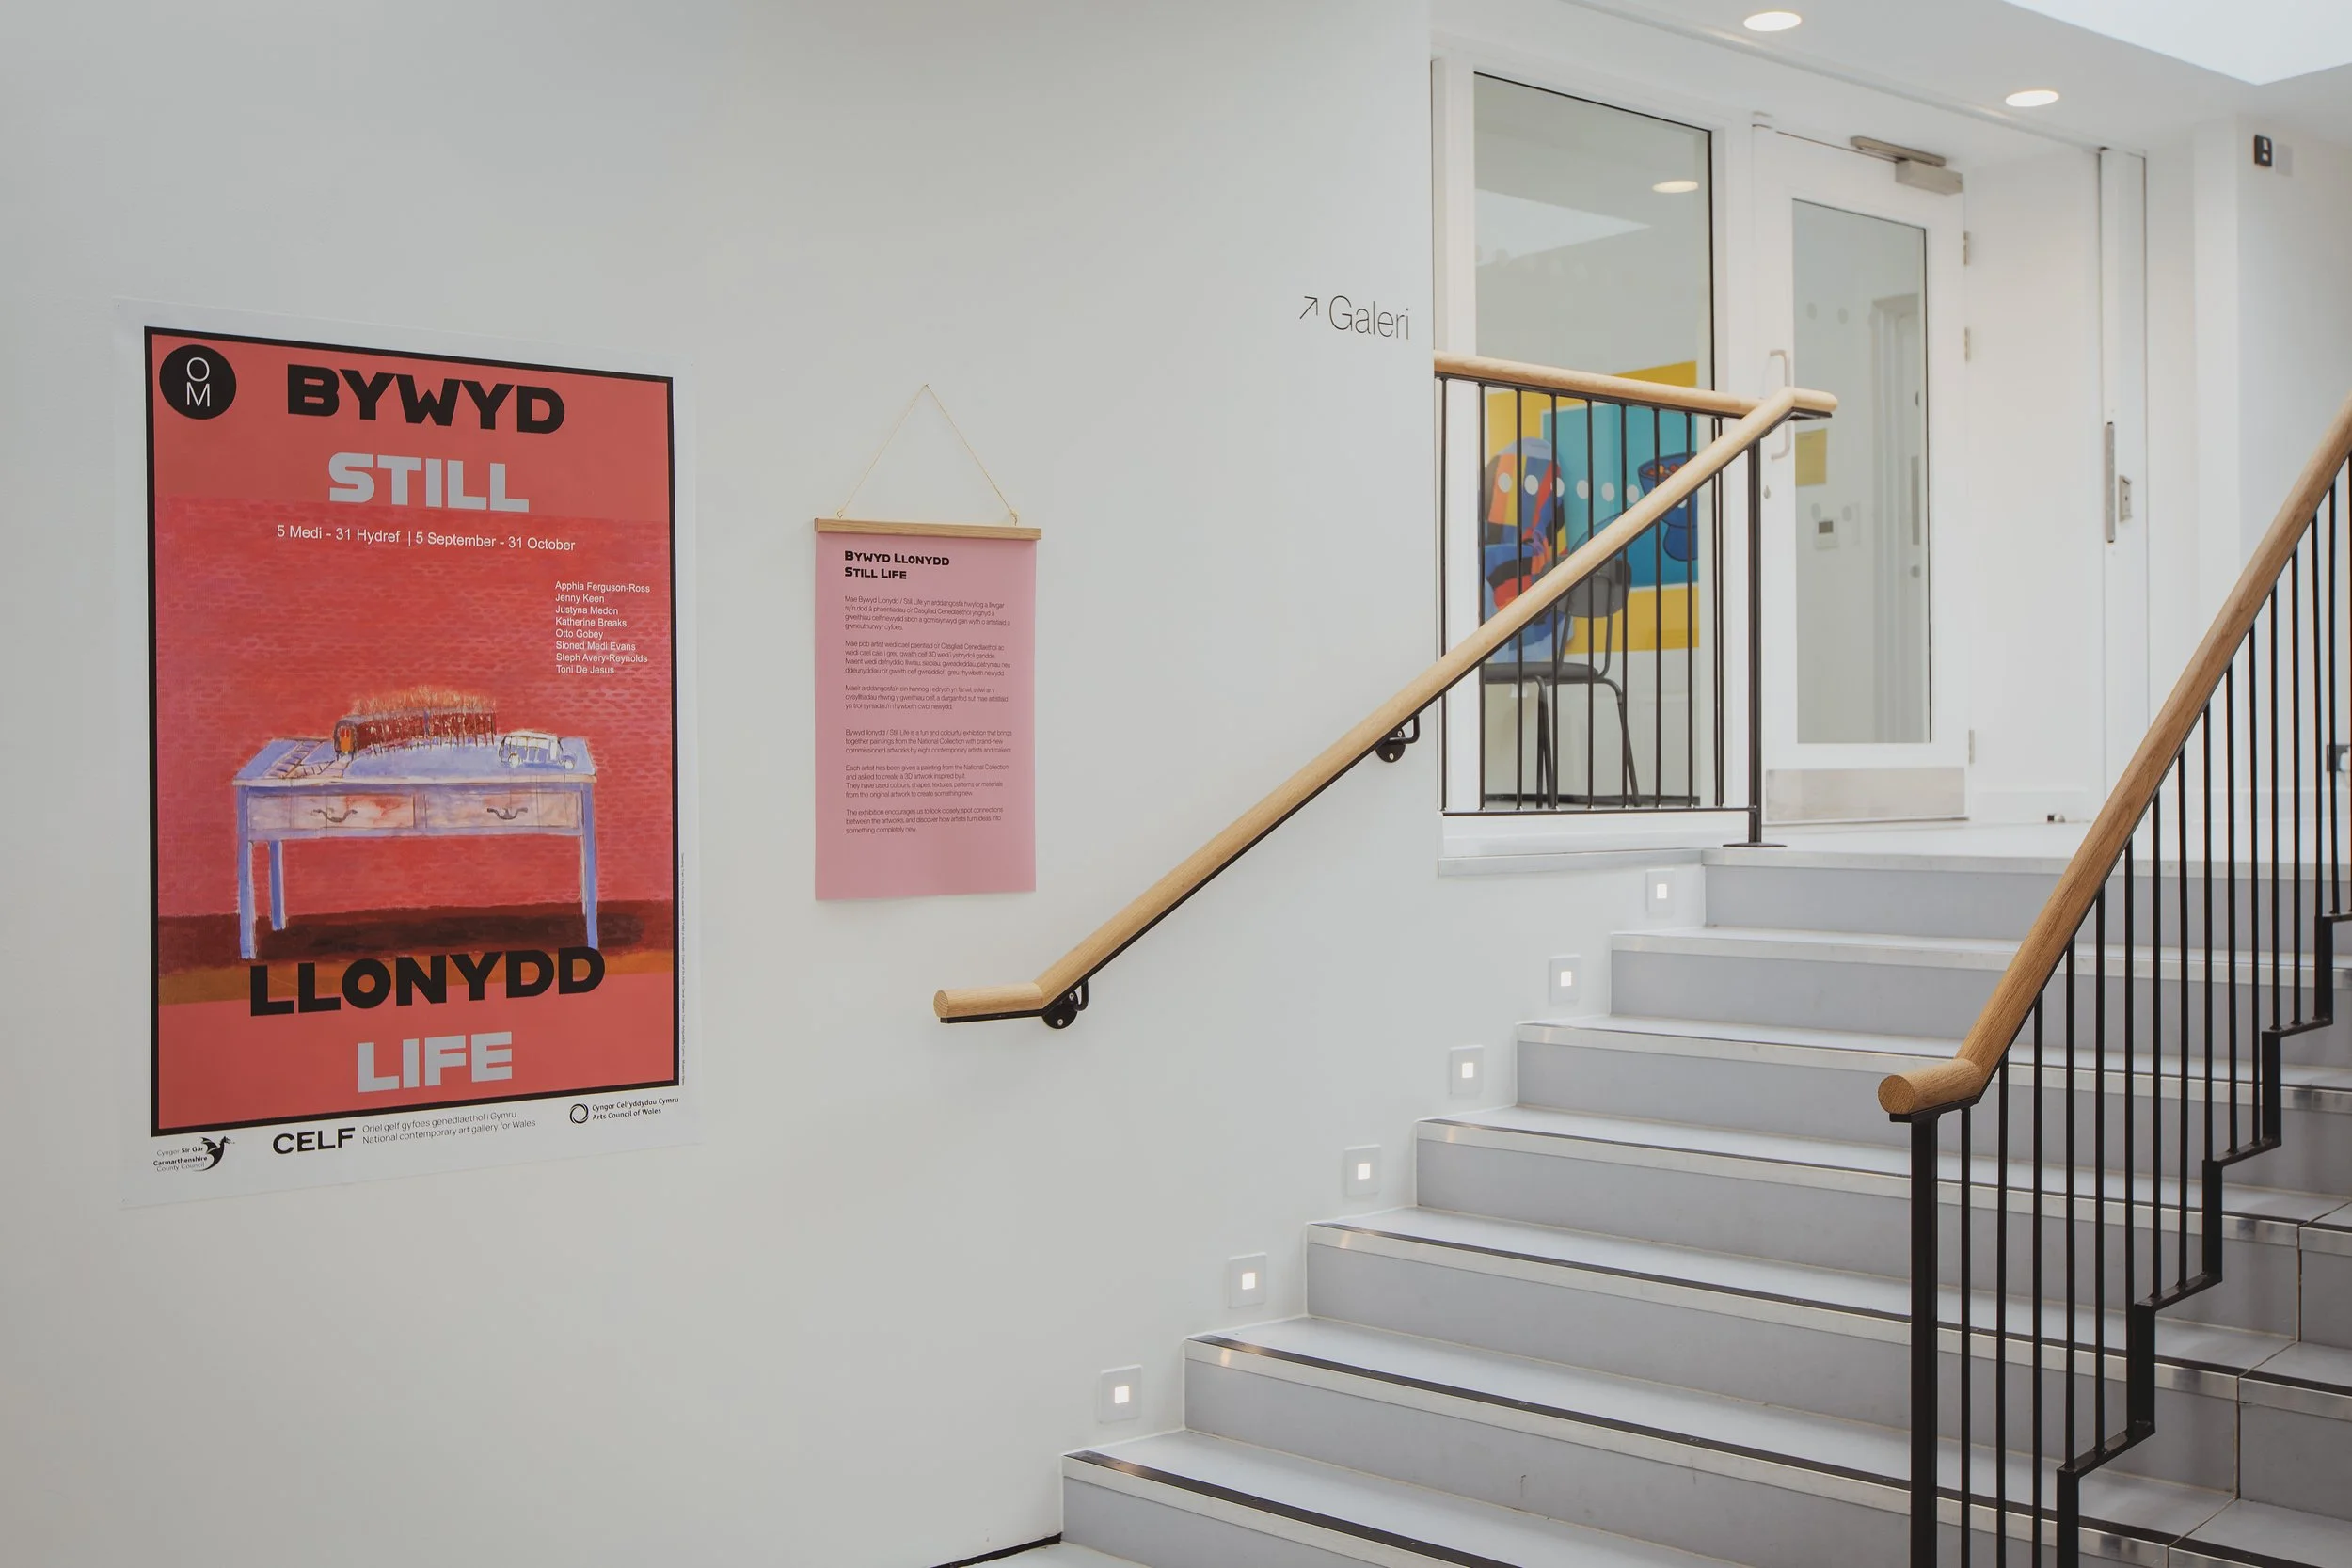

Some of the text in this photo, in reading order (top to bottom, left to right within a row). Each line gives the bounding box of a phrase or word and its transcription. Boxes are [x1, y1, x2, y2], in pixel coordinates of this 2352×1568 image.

[1328, 294, 1409, 340] Galeri
[287, 363, 565, 434] BYWYD
[328, 451, 530, 513] STILL
[277, 525, 285, 537] 5
[290, 526, 323, 539] Medi
[336, 528, 351, 541] 31
[357, 529, 400, 546] Hydref
[416, 531, 423, 544] 5
[427, 532, 496, 548] September
[508, 537, 523, 548] 31
[528, 537, 576, 551] October
[555, 581, 650, 593] Apphia Ferguson-Ross
[555, 594, 605, 604] Jenny Keen
[555, 606, 618, 615] Justyna Medon
[556, 617, 628, 627] Katherine Breaks
[556, 629, 603, 640] Otto Gobey
[556, 641, 636, 651] Sioned Medi Evans
[556, 653, 648, 664] Steph Avery-Reynolds
[557, 665, 614, 674] Toni De Jesus
[250, 946, 605, 1016] LLONYDD
[358, 1031, 512, 1093] LIFE
[616, 1099, 657, 1109] Celfyddydau
[658, 1097, 679, 1105] Cymru
[608, 1110, 632, 1119] Council
[362, 1124, 383, 1133] Oriel
[384, 1122, 401, 1133] gelf
[402, 1118, 431, 1132] gyfoes
[432, 1114, 485, 1128] genedlaethol
[490, 1112, 517, 1121] Gymru
[362, 1134, 398, 1145] National
[399, 1129, 457, 1141] contemporary
[471, 1124, 499, 1134] gallery
[512, 1119, 536, 1129] Wales
[273, 1127, 356, 1155] CELF
[153, 1156, 208, 1165] Carmarthenshire
